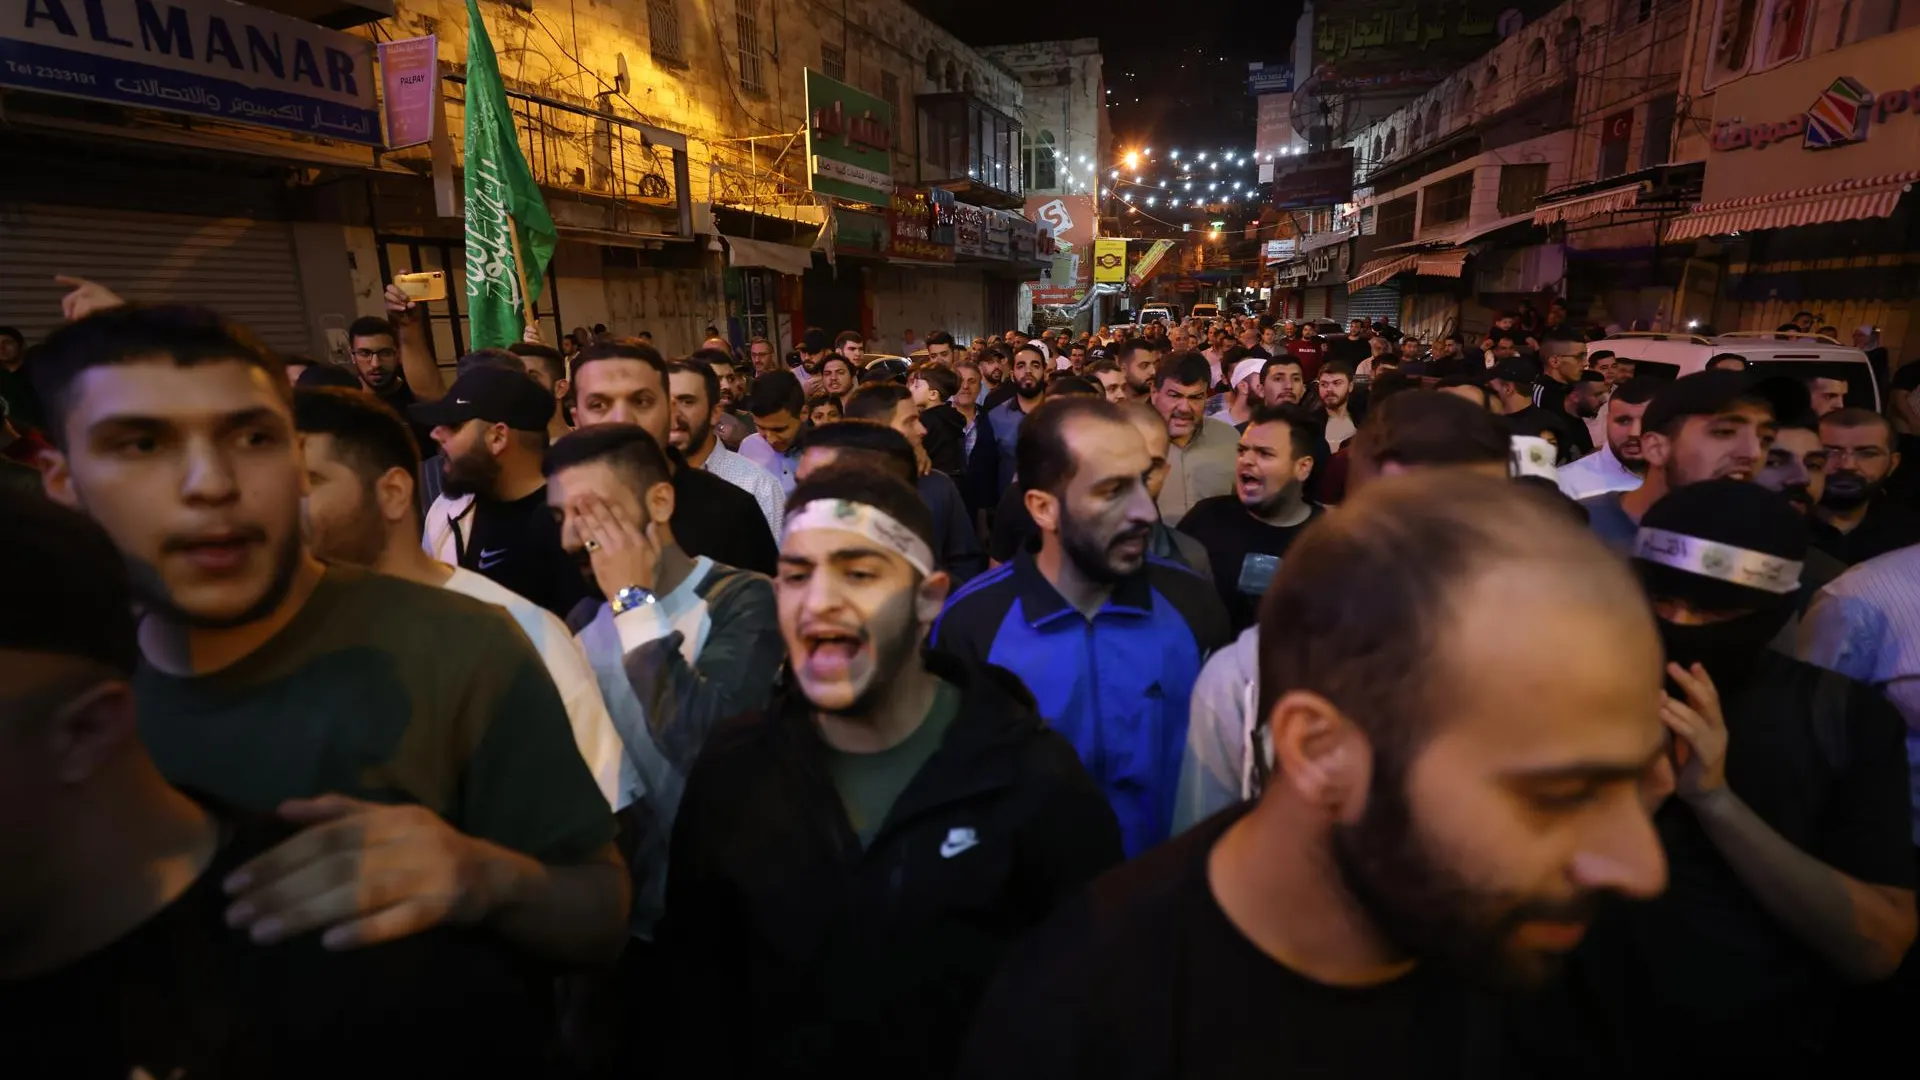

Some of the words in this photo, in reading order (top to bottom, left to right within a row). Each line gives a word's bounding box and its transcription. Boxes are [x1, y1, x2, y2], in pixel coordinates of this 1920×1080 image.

[24, 0, 358, 96] ALMANAR
[5, 59, 32, 75] Tel
[114, 78, 221, 111] والاتصالات
[310, 105, 371, 135] المنار
